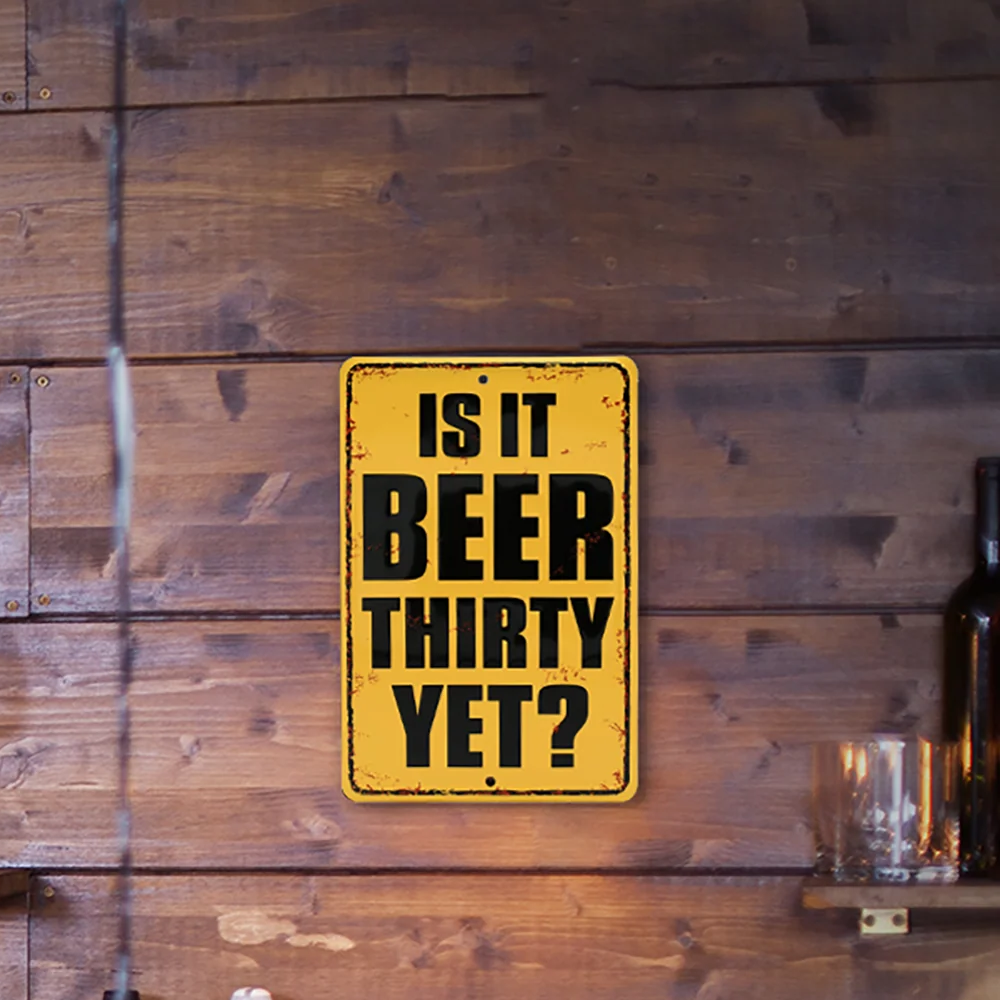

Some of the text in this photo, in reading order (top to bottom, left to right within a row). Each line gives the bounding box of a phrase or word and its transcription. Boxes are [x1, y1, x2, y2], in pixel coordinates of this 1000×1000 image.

[419, 393, 557, 458] IS IT
[362, 473, 614, 581] BEER
[362, 597, 615, 669] THIRTY
[392, 684, 589, 768] YET?
